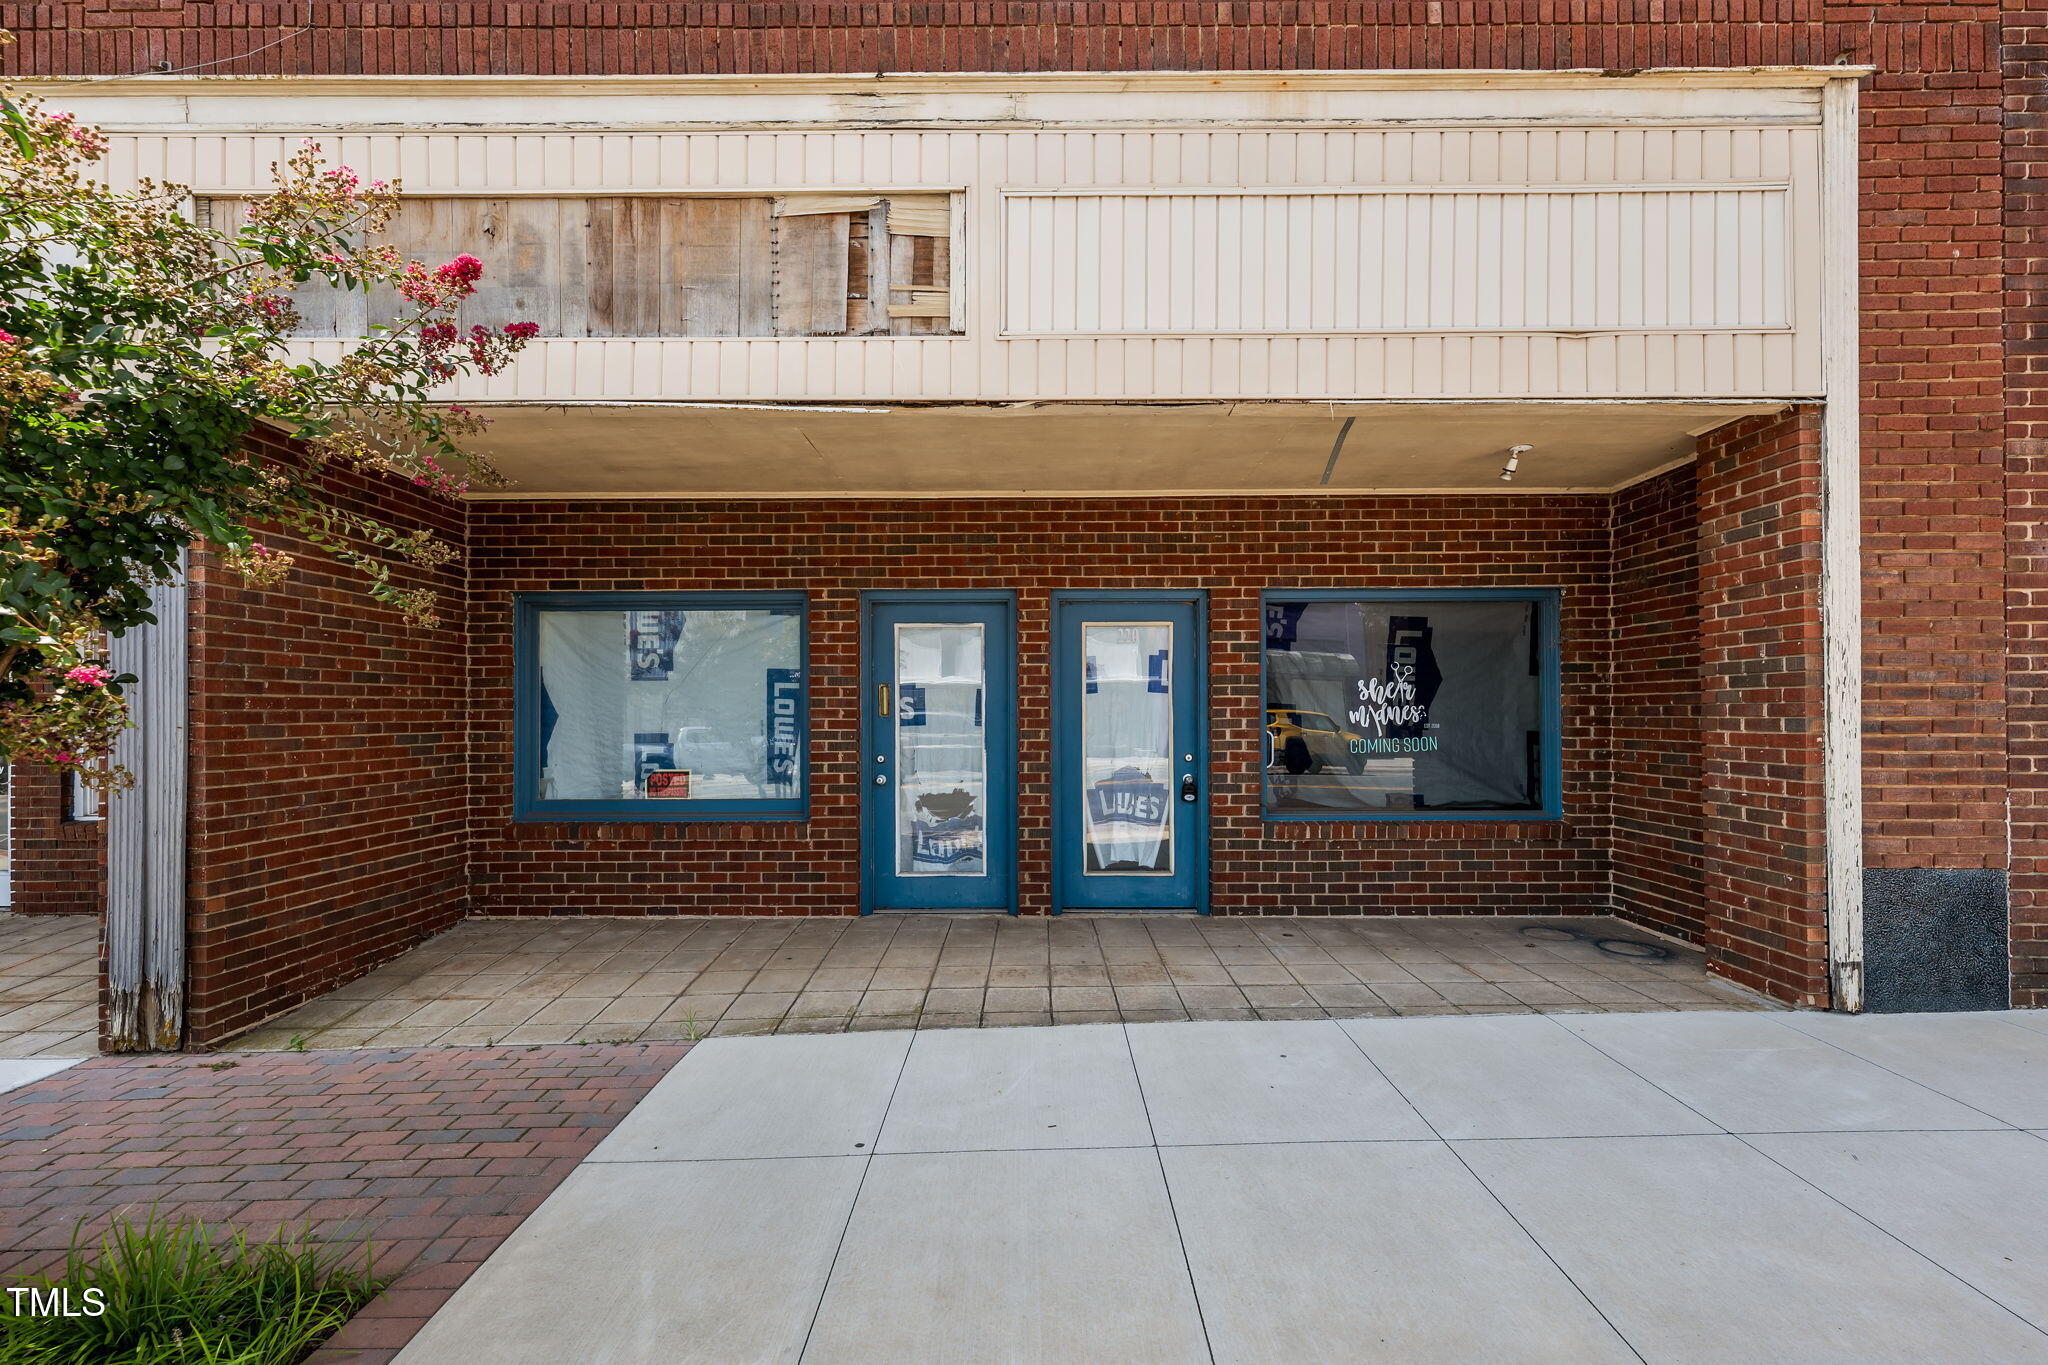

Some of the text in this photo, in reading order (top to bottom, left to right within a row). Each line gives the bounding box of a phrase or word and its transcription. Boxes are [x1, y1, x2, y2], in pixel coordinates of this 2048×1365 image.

[1350, 736, 1438, 755] COMING SOON
[649, 773, 687, 786] POSTED
